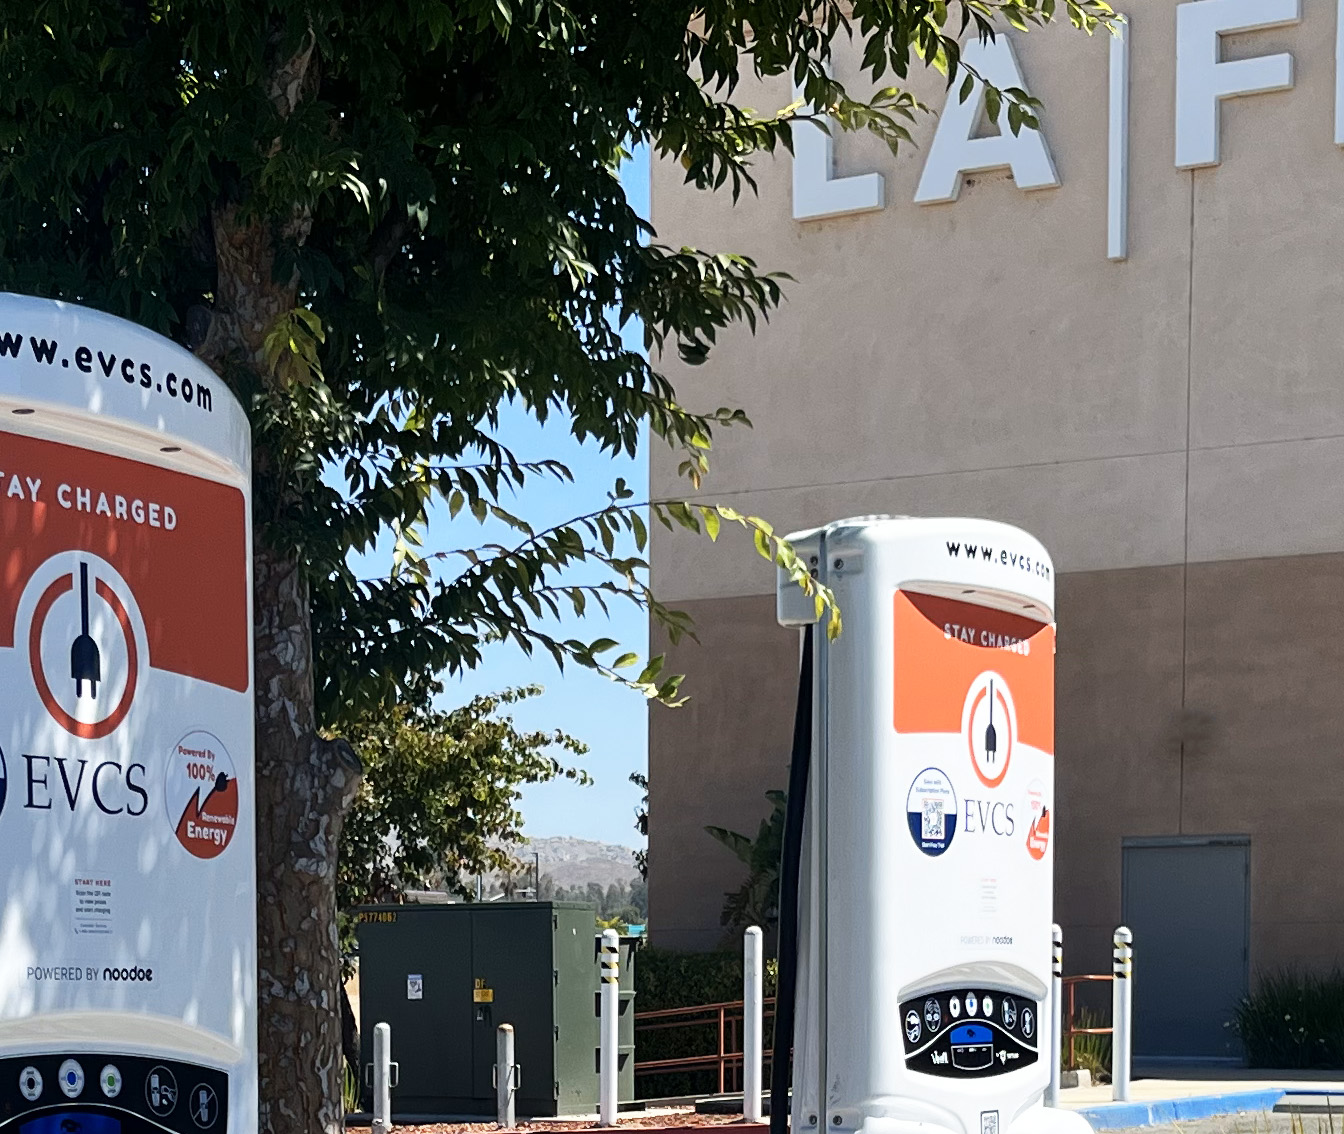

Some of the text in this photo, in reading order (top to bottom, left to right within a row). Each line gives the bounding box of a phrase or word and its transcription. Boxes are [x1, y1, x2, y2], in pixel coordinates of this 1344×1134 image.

[792, 32, 1060, 222] LA
[57, 483, 177, 530] CHARGED
[944, 623, 1030, 656] STAY CHARGED
[21, 754, 149, 817] EVCS
[186, 762, 216, 782] 100%
[187, 820, 228, 846] Energy
[964, 798, 1015, 837] EVCS
[27, 966, 153, 982] POWERED BY noodoe
